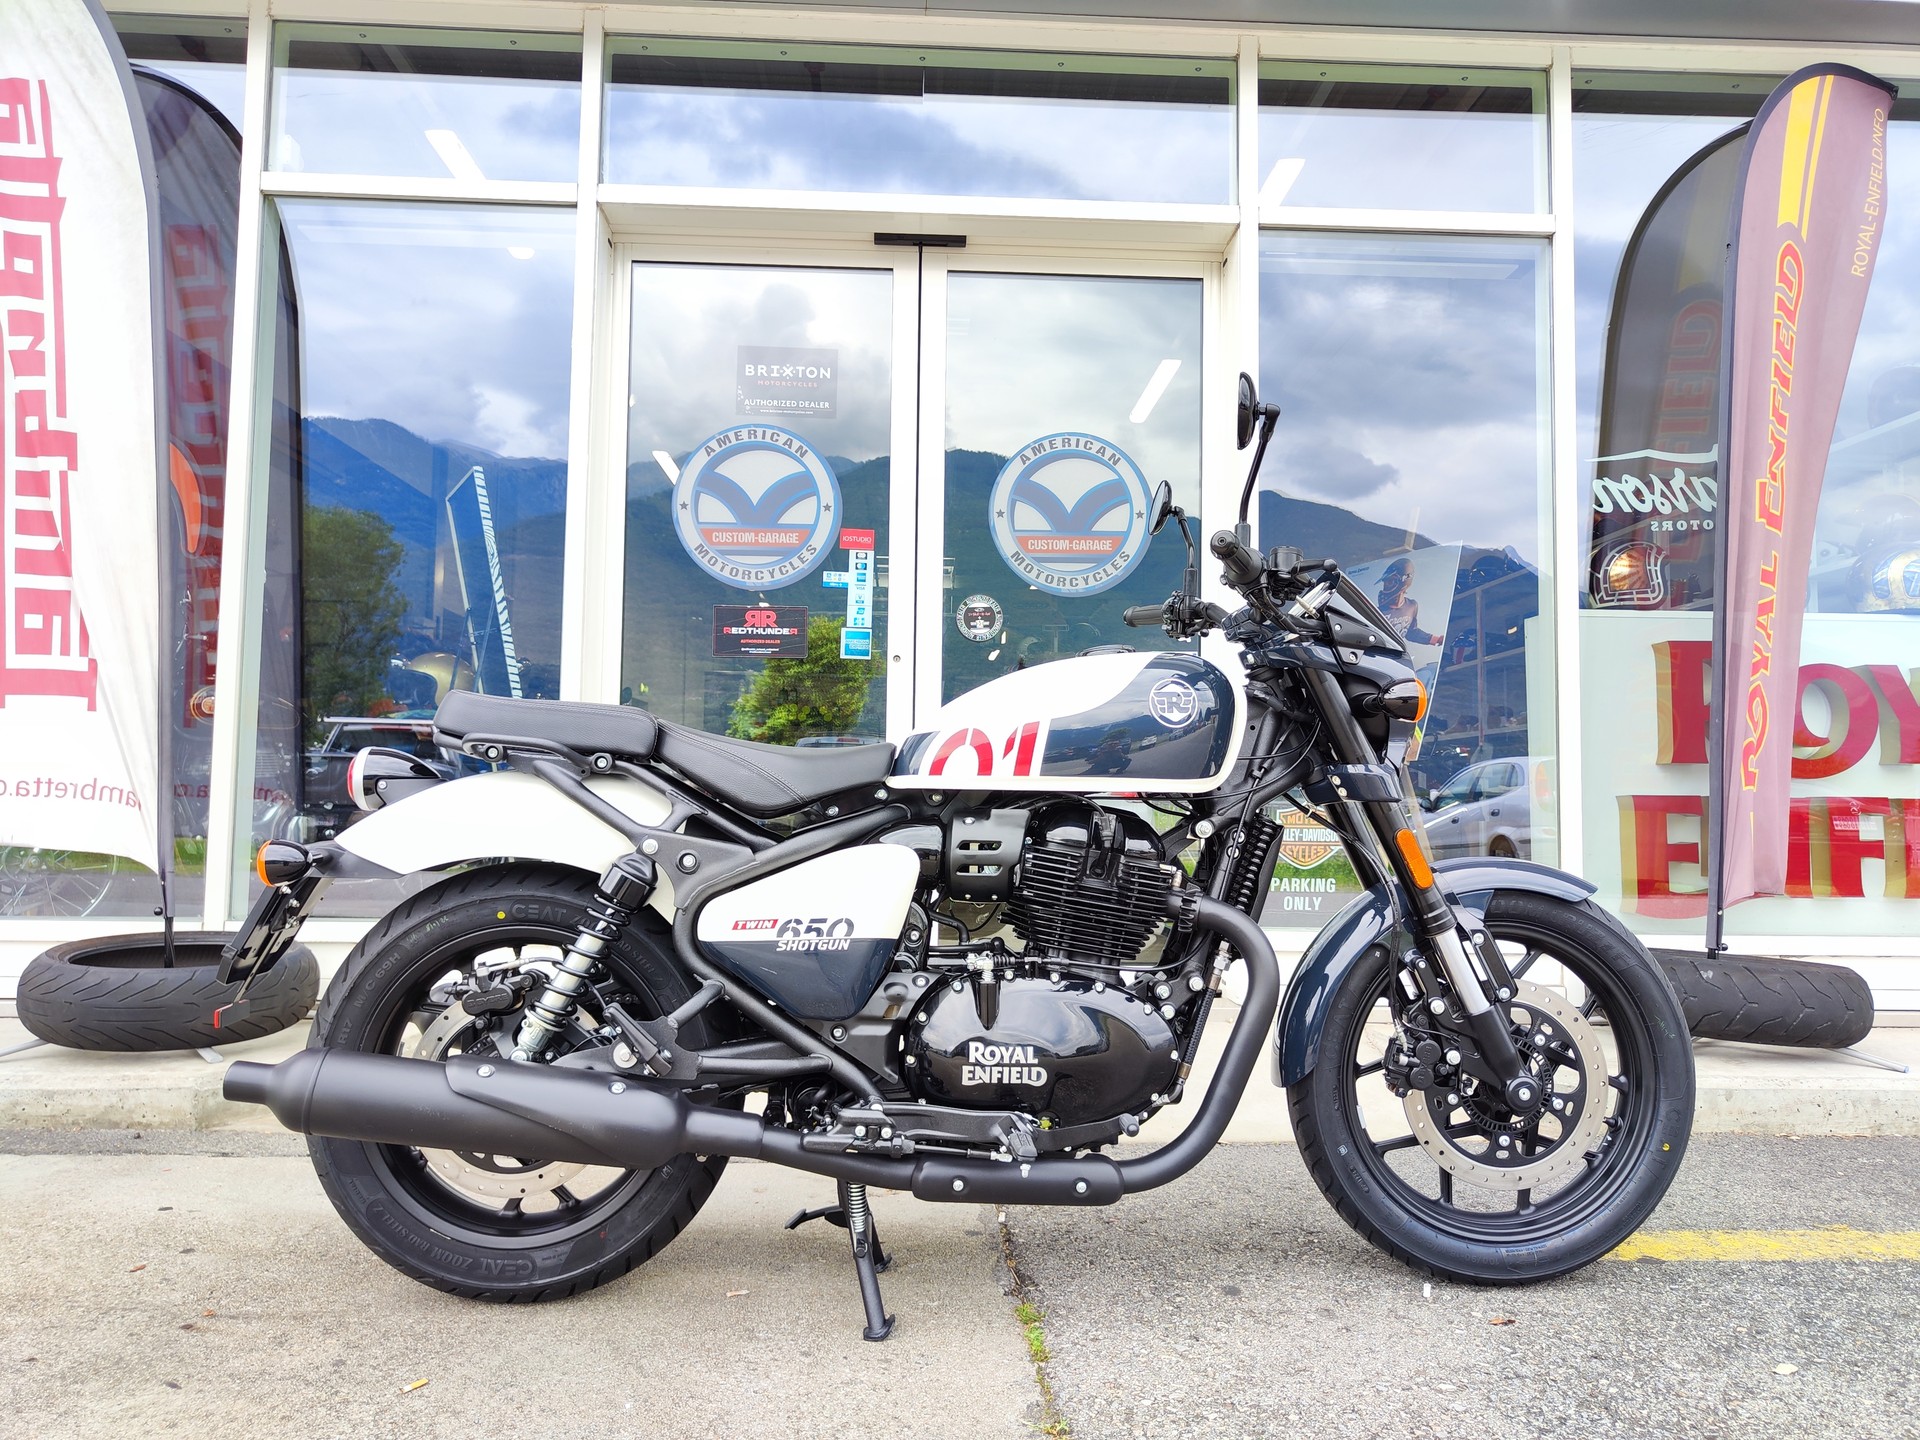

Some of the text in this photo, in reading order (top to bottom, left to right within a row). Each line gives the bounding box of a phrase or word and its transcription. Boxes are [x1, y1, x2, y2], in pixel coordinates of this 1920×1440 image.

[1850, 108, 1885, 278] ROYAL-ENFIELD.INFO
[745, 363, 832, 380] BRIXTON
[757, 380, 818, 388] MOTORCYCLES
[744, 398, 830, 409] AUTHORIZED DEALER
[704, 428, 809, 459] AMERICAN
[1019, 437, 1122, 467] AMERICAN
[1740, 240, 1805, 792] ROYAL ENFIELD
[712, 531, 800, 545] CUSTOM-GARAGE
[1027, 539, 1113, 551] CUSTOM-GARAGE
[694, 543, 818, 581] MOTORCYCLES
[1010, 550, 1130, 588] MOTORCYCLES
[723, 627, 798, 635] REDTHUNDER
[1286, 845, 1325, 862] CYCLES
[1270, 877, 1336, 893] PARKING
[1283, 896, 1322, 911] ONLY
[511, 903, 567, 923] CEAT
[736, 919, 772, 930] TWIN
[776, 918, 855, 938] 650
[776, 938, 851, 952] SHOTGUN
[968, 1041, 1039, 1066] ROYAL
[961, 1065, 1048, 1087] ENFIELD
[476, 1257, 534, 1278] CEAT
